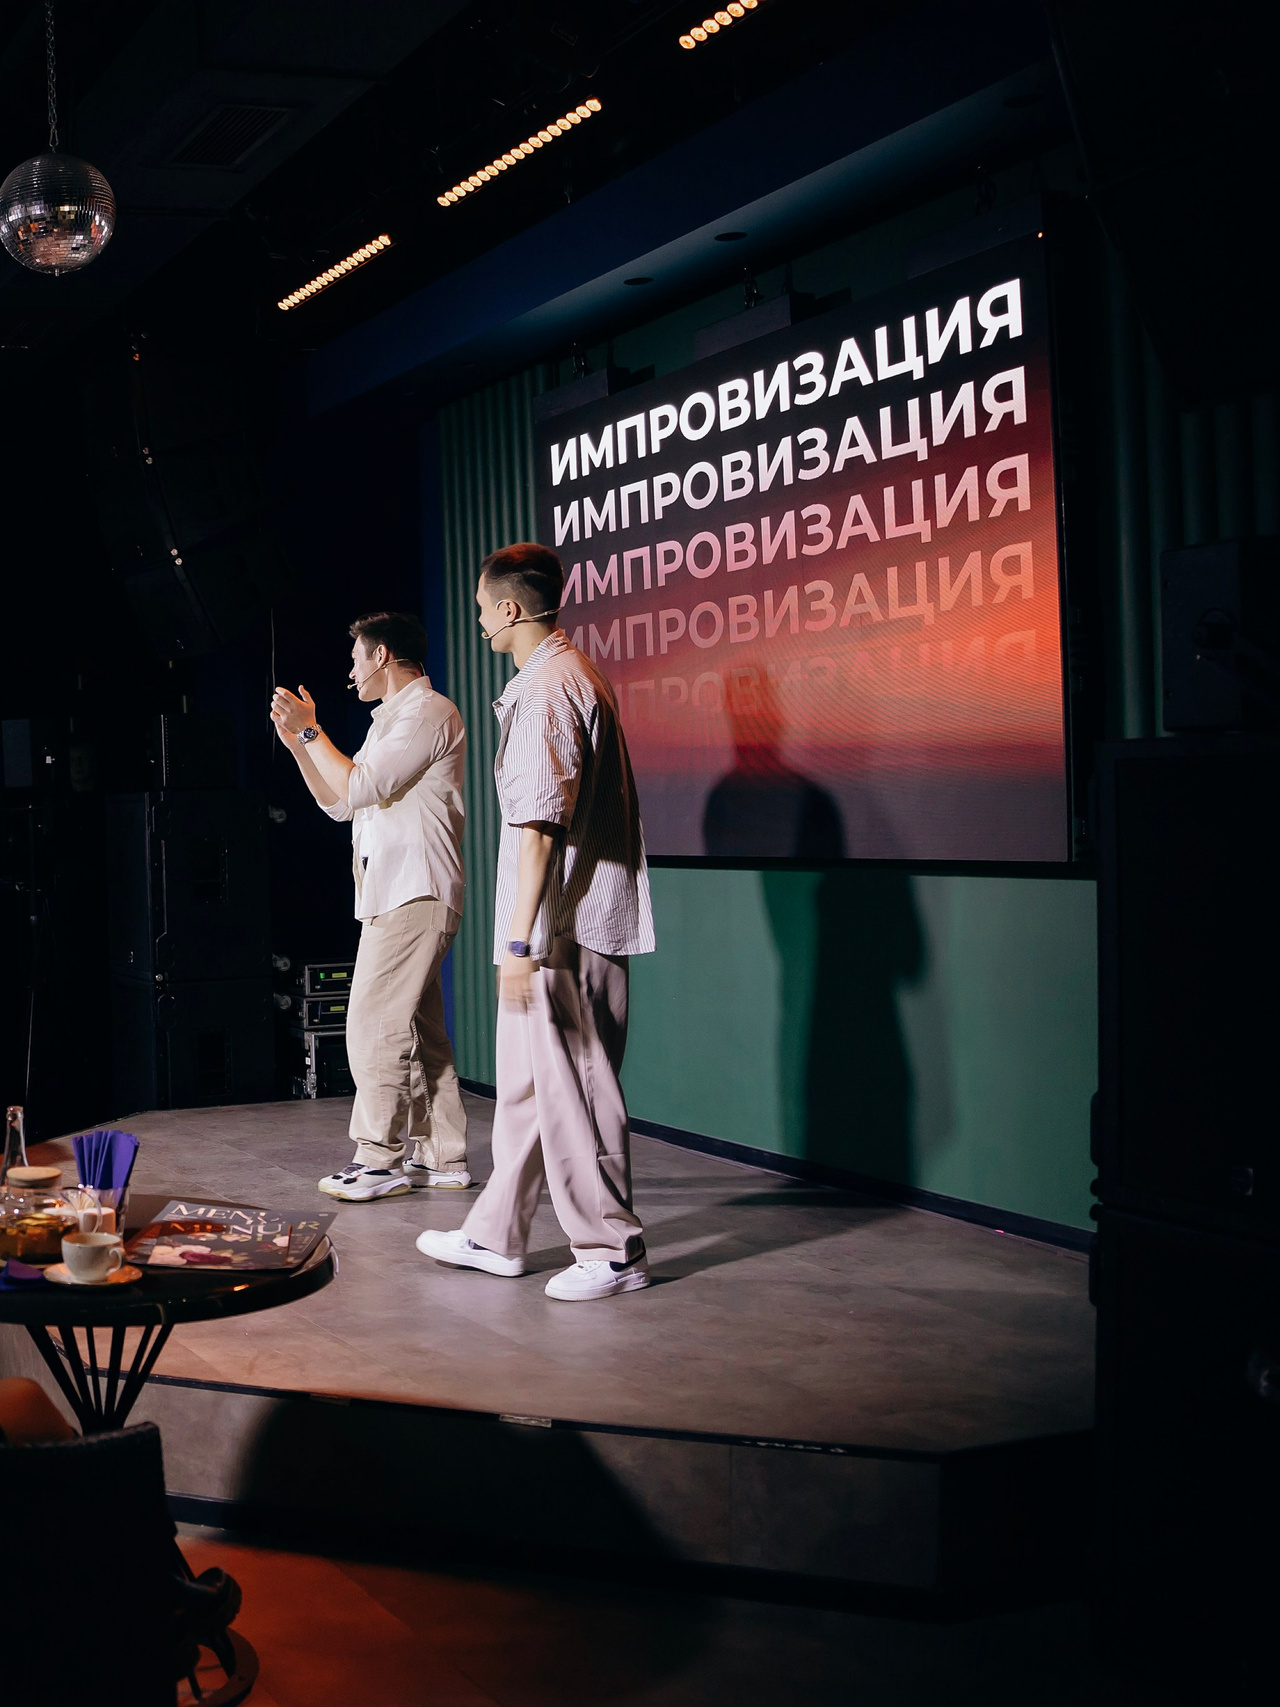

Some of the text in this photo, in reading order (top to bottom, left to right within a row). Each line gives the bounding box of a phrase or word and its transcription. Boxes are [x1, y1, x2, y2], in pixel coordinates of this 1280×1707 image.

[550, 278, 1024, 486] ИМПРОВИЗАЦИЯ
[553, 366, 1028, 547] ИМПРОВИЗАЦИЯ
[560, 453, 1032, 607] ИМПРОВИЗАЦИЯ
